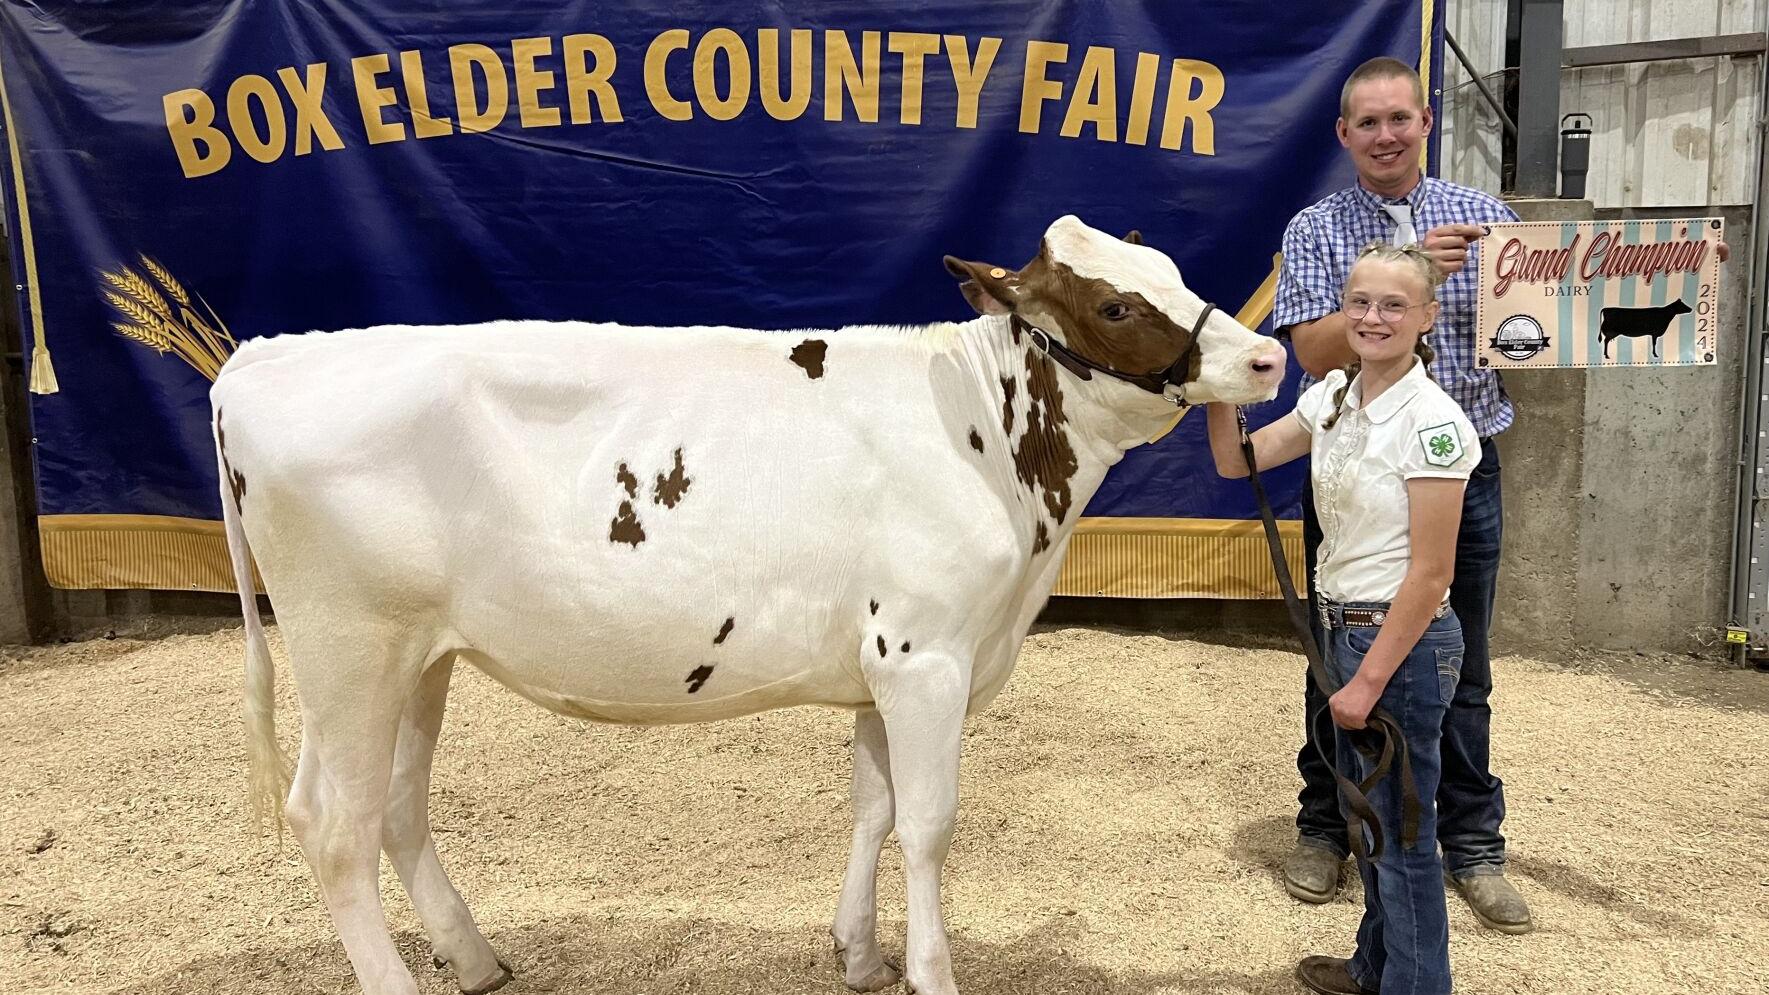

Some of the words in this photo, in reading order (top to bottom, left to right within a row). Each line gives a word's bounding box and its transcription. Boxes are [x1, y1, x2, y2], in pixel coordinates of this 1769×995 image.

[162, 62, 345, 179] BOX
[351, 33, 624, 144] ELDER
[643, 27, 1003, 129] COUNTY
[1018, 40, 1226, 156] FAIR
[1493, 233, 1581, 298] Grand
[1580, 228, 1708, 285] Champion
[1544, 285, 1593, 297] DAIRY
[1696, 284, 1710, 350] 2024
